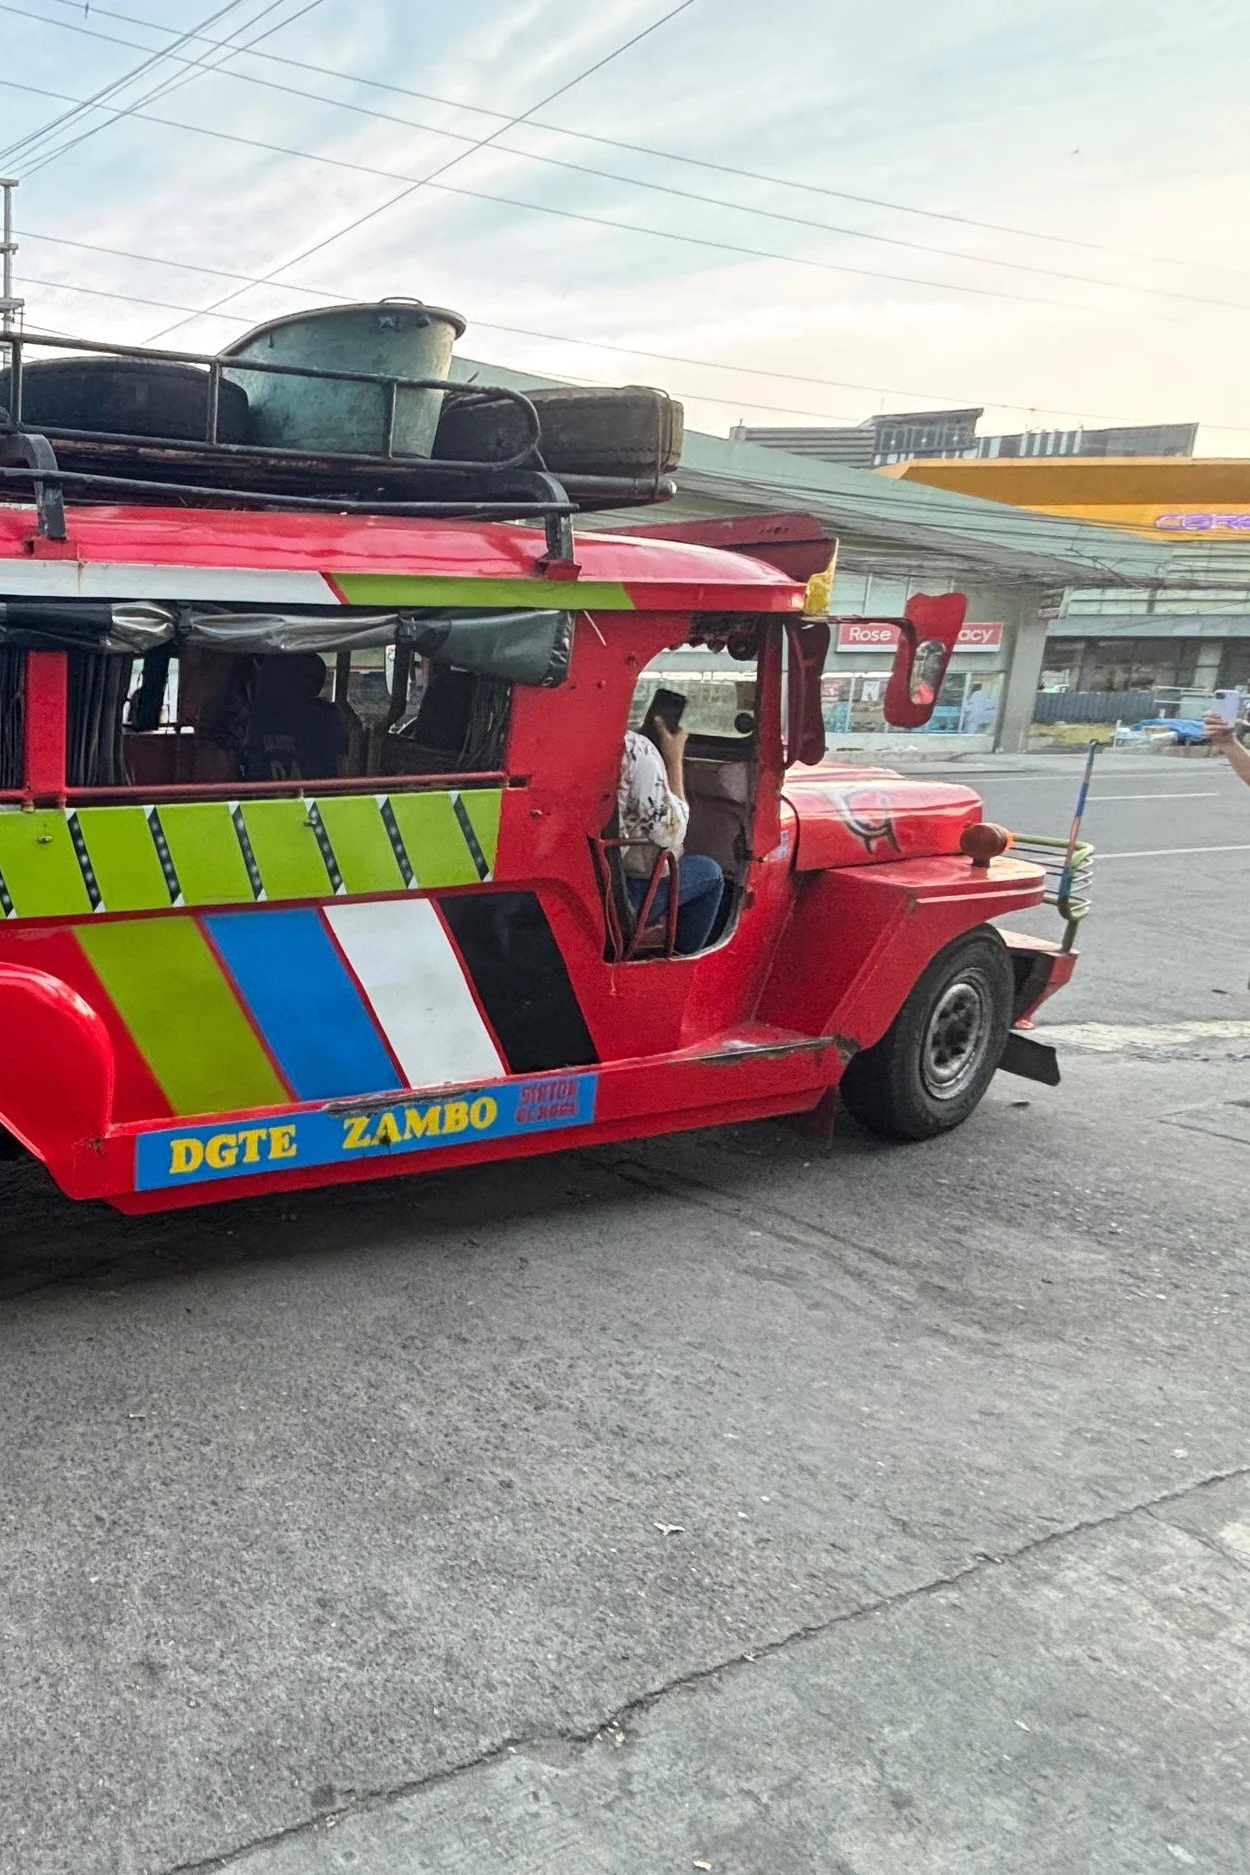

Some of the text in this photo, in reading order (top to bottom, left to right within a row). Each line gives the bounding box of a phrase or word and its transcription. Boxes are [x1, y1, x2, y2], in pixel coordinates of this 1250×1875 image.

[849, 627, 892, 641] Rose
[170, 1096, 498, 1175] DGTE ZAMBO
